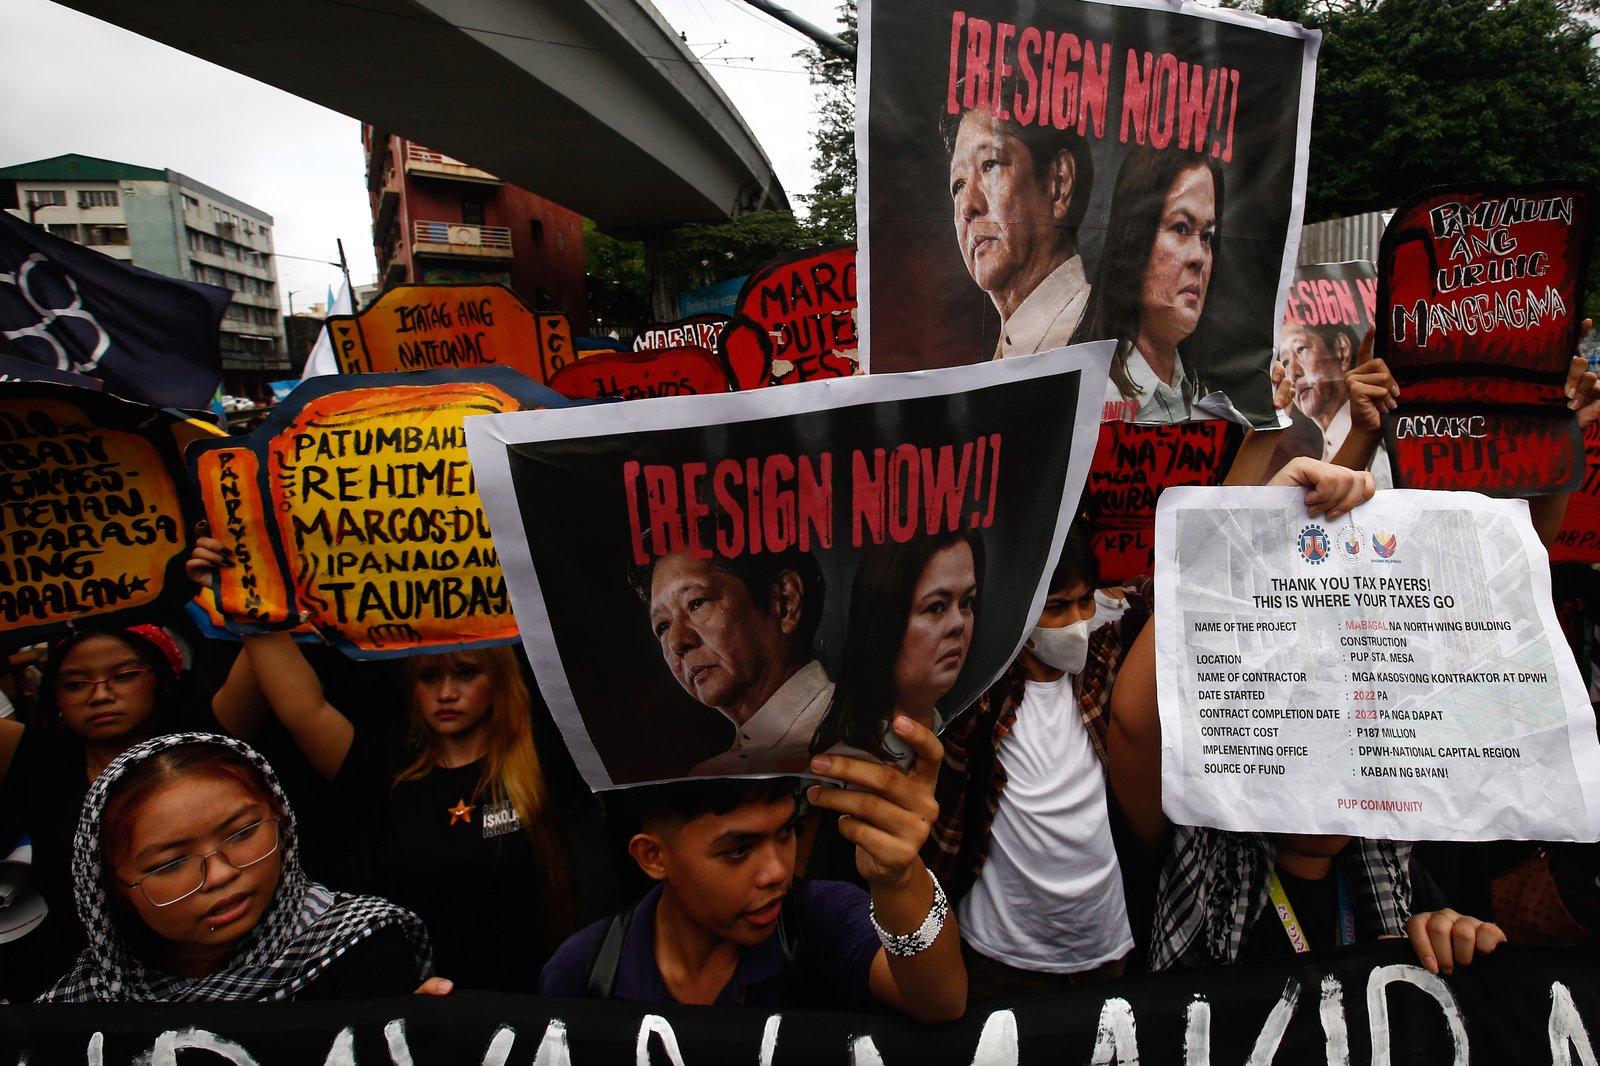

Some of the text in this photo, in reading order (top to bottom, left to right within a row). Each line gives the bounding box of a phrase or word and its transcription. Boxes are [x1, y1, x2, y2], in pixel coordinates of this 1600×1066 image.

[1449, 228, 1517, 264] ANG
[1437, 252, 1550, 294] URING
[395, 299, 494, 334] ITATAG ANG
[1392, 285, 1567, 348] MANGGAGAWA
[398, 332, 496, 368] NATIONAL
[1424, 438, 1518, 474] PUP
[1093, 469, 1147, 484] MGA
[328, 546, 500, 577] IPANALO AN
[1271, 576, 1431, 592] THANK YOU TAX PAYERS!
[318, 576, 514, 623] TAUMBAY
[1253, 593, 1455, 609] THIS IS WHERE YOUR TAXES GO
[1194, 622, 1221, 632] NAME
[1223, 622, 1236, 632] OF
[1236, 622, 1254, 632] THE
[1256, 621, 1297, 632] PROJECT
[1345, 620, 1388, 631] MABAGAL
[1389, 621, 1402, 631] NA
[1465, 621, 1511, 631] BUILDING
[1340, 636, 1407, 648] CONSTRUCTION
[1196, 654, 1242, 665] LOCATION
[1350, 652, 1369, 662] PUP
[1371, 652, 1388, 662] STA.
[1389, 653, 1414, 663] MESA
[1197, 672, 1225, 682] NAME
[1227, 672, 1240, 682] OF
[1242, 672, 1307, 682] CONTRACTOR
[1352, 672, 1376, 682] MGA
[1376, 672, 1429, 684] KASOSYONG
[1431, 673, 1500, 684] KONTRAKTOR
[1502, 673, 1516, 683] AT
[1518, 673, 1548, 683] DPWH
[1198, 690, 1221, 700] DATE
[1223, 690, 1265, 700] STARTED
[1353, 690, 1375, 701] 2022
[1377, 690, 1388, 701] PA
[1199, 708, 1249, 719] CONTRACT
[1252, 708, 1314, 719] COMPLETION
[1316, 709, 1340, 719] DATE
[1355, 709, 1377, 720] 2023
[1379, 709, 1391, 720] PA
[1391, 710, 1410, 720] NGA
[1412, 710, 1443, 721] DAPAT
[1201, 726, 1251, 737] CONTRACT
[1253, 727, 1279, 738] COST
[1356, 728, 1380, 738] P187
[1381, 728, 1416, 739] MILLION
[1202, 745, 1274, 756] IMPLEMENTING
[1276, 746, 1308, 756] OFFICE
[1358, 746, 1436, 757] DPWH-NATIONAL
[1438, 747, 1480, 758] CAPITAL
[1482, 748, 1520, 758] REGION
[1204, 763, 1241, 774] SOURCE
[1243, 764, 1256, 774] OF
[1258, 764, 1286, 775] FUND
[1360, 766, 1397, 777] KABAN
[1400, 767, 1413, 778] NG
[1415, 768, 1449, 778] BAYAN!
[1337, 798, 1423, 812] PUP COMMUNITY
